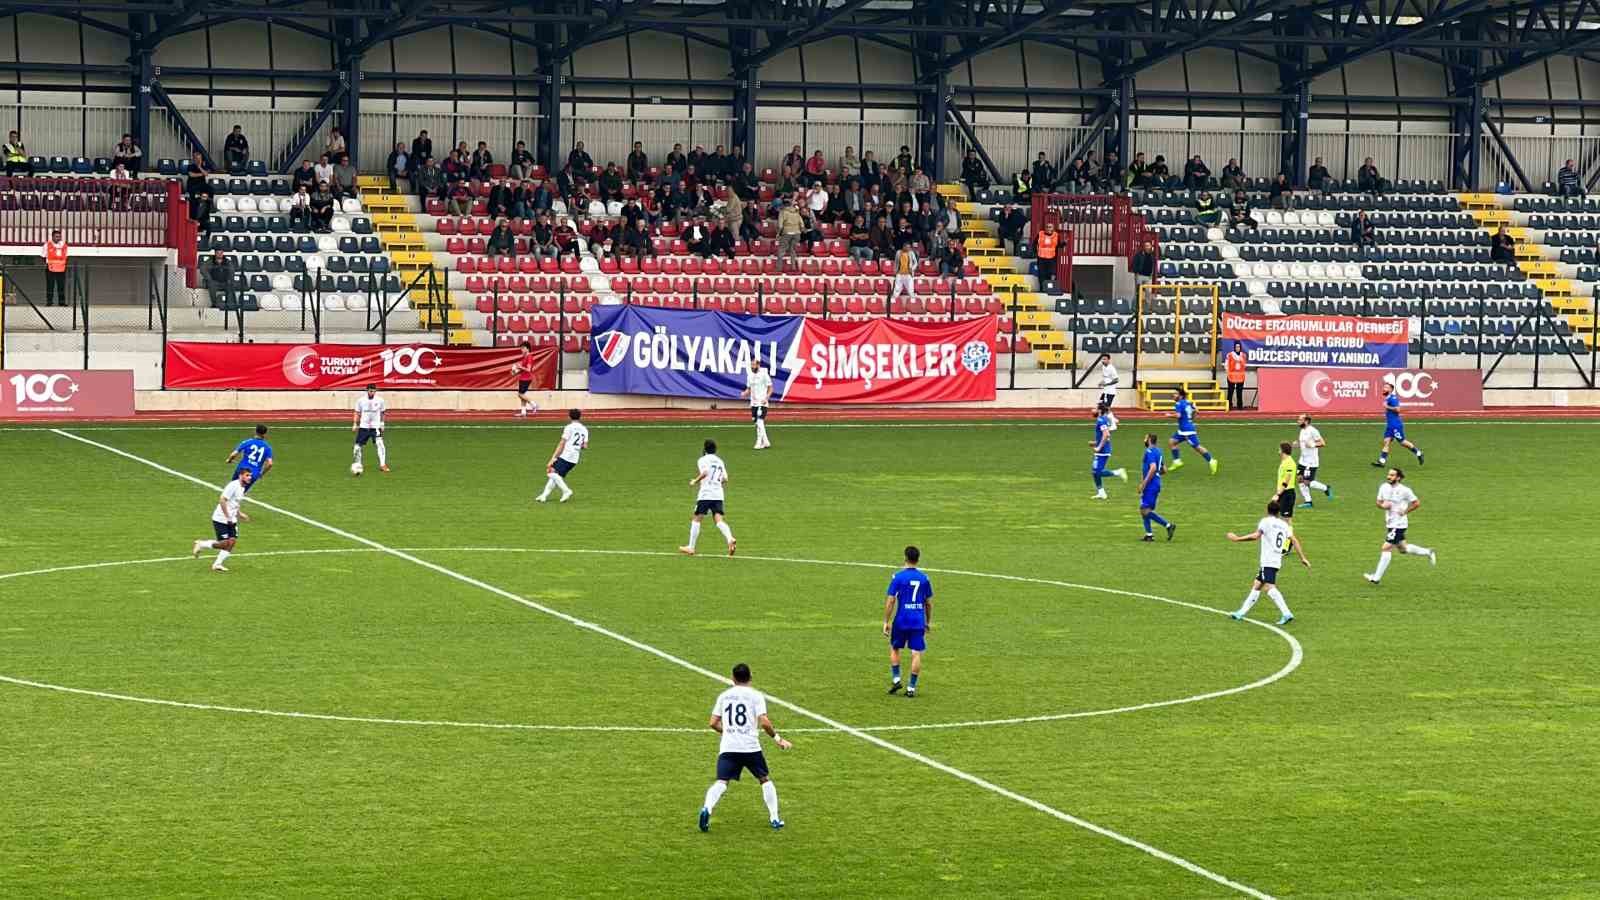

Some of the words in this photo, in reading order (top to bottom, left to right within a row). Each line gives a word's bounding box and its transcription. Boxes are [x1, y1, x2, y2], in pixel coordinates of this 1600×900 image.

[1227, 316, 1262, 330] DÜZCE
[1266, 319, 1353, 332] ERZURUMLULAR
[1356, 320, 1404, 334] DERNEĞİ
[1265, 335, 1324, 349] DADAŞLAR
[1327, 336, 1364, 348] GRUBU
[810, 335, 957, 389] ŞİMŞEKLER
[1248, 348, 1328, 362] DÜZCESPORUN
[1332, 351, 1380, 364] YANINDA
[248, 444, 265, 462] 21
[1276, 532, 1284, 549] 6
[910, 580, 920, 602] 7
[725, 703, 747, 727] 18
